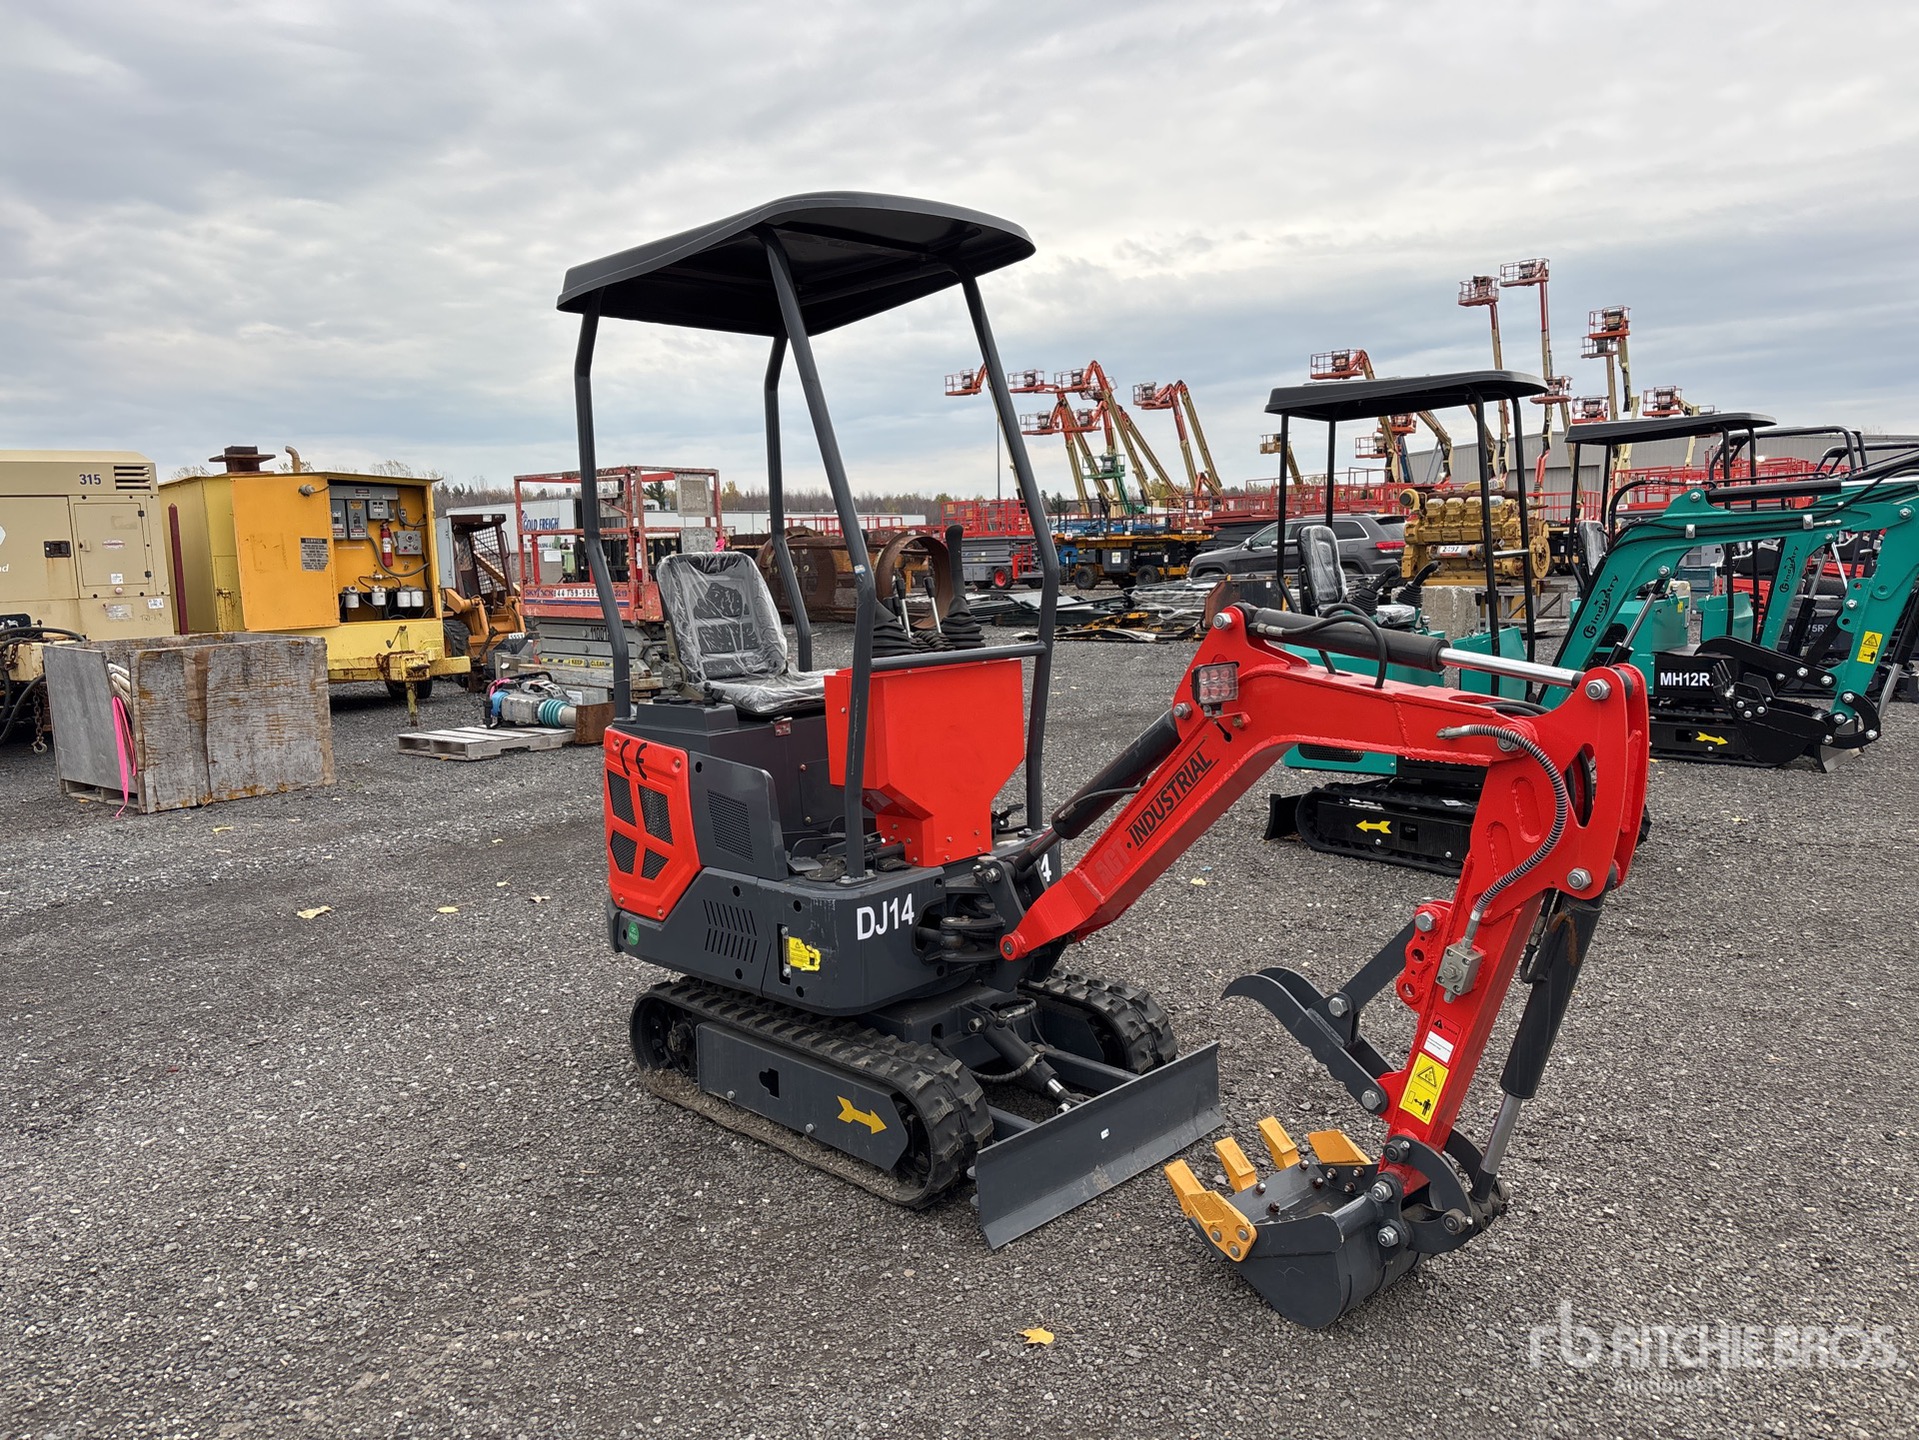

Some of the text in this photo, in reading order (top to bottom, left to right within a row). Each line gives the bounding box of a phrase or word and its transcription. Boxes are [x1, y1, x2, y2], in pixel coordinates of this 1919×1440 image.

[79, 474, 101, 485] 315
[1660, 672, 1714, 687] MH12R
[1130, 750, 1213, 847] INDUSTRIAL
[856, 893, 915, 941] DJ14
